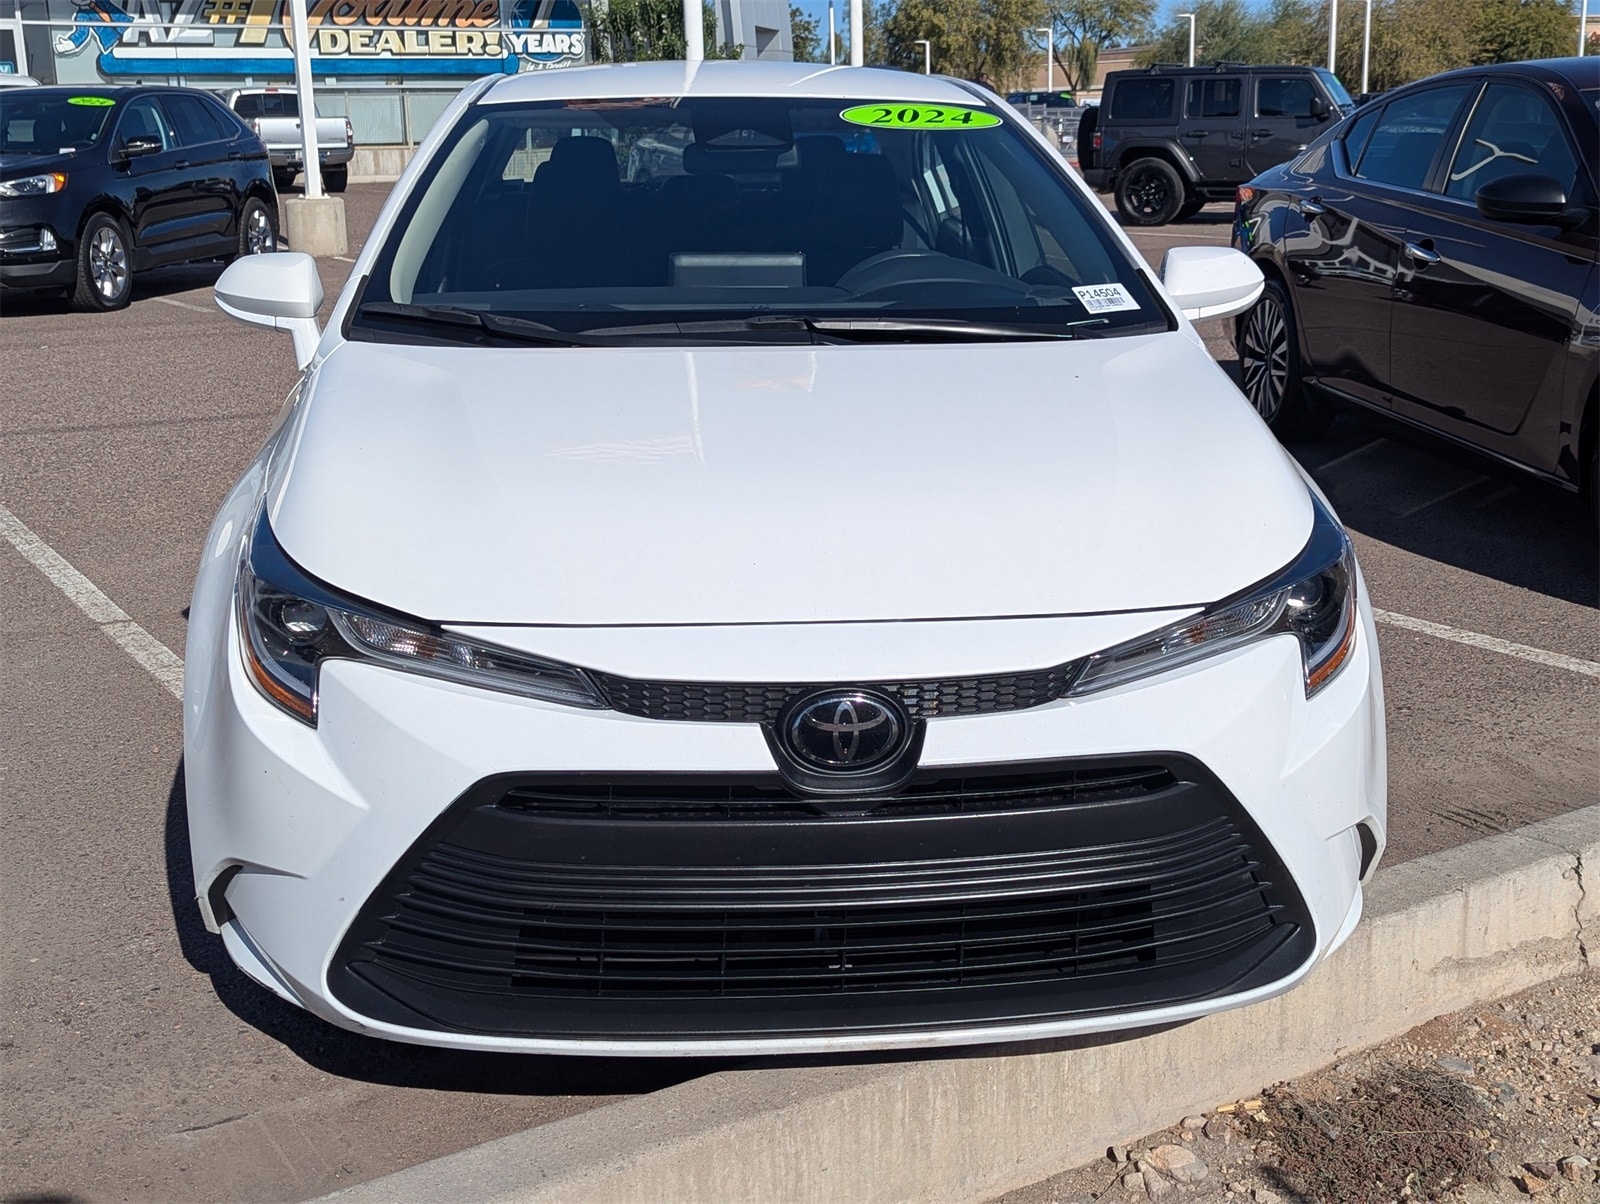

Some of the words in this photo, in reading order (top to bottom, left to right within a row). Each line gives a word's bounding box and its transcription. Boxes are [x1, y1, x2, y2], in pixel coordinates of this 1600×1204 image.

[318, 29, 502, 55] DEALER!
[508, 33, 583, 54] YEARS
[871, 108, 973, 125] 2024
[1078, 287, 1121, 299] P14504
